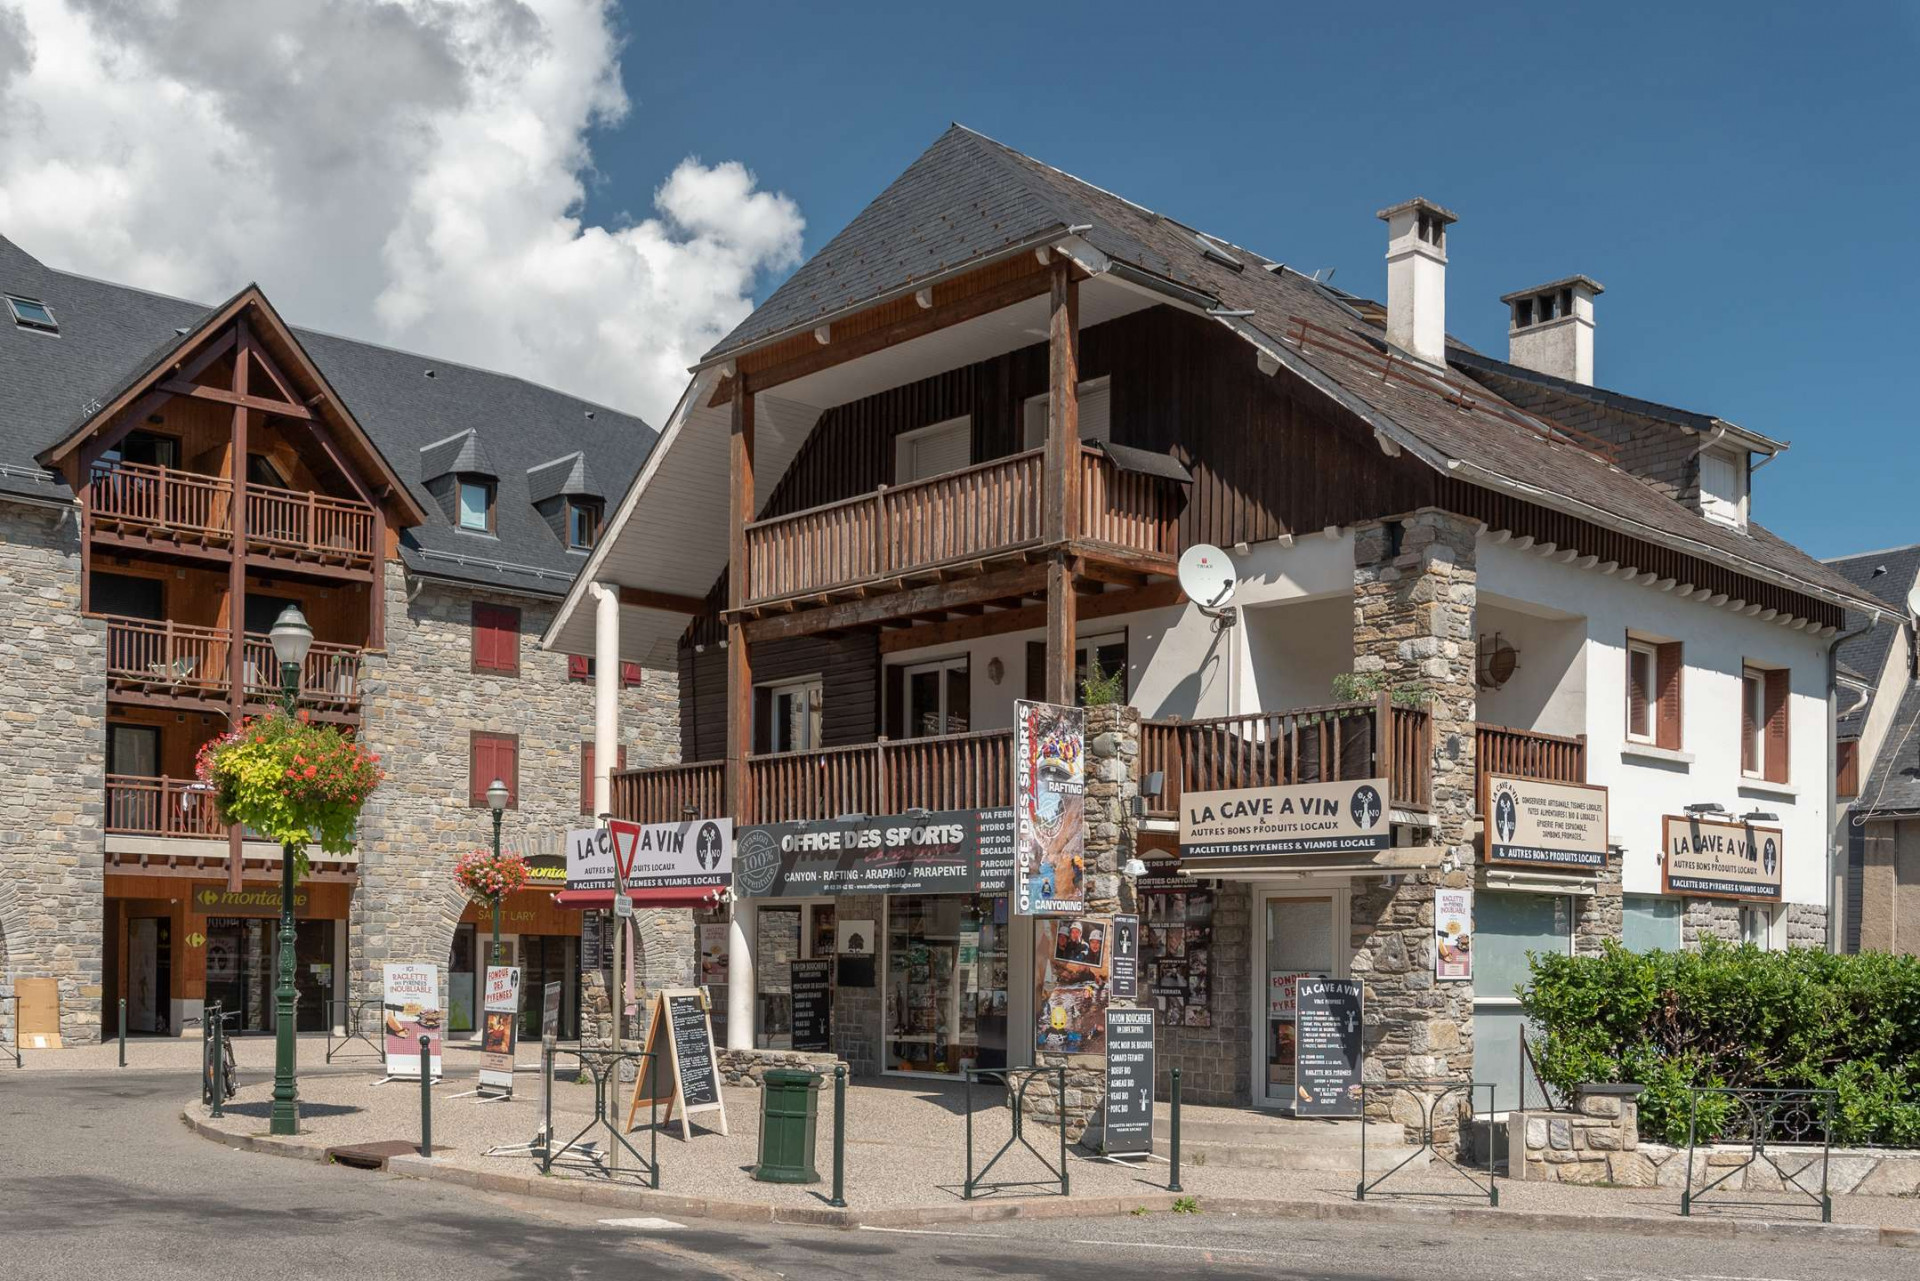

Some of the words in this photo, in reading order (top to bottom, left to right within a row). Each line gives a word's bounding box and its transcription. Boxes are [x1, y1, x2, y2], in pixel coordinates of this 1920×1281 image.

[1019, 705, 1030, 788] SPORTS
[1049, 782, 1082, 794] RAFTING
[1496, 781, 1508, 792] CAVE
[1522, 796, 1547, 806] CONSERVERIE
[1020, 793, 1030, 832] DES
[1190, 806, 1215, 825] LA
[1220, 798, 1273, 818] CAVE
[1280, 798, 1294, 814] A
[1300, 798, 1338, 817] VIN
[1191, 828, 1224, 837] AUTRES
[1228, 826, 1251, 835] BONS
[1253, 824, 1298, 833] PRODUITS
[1301, 822, 1338, 831] LOCAUX
[577, 838, 594, 860] LA
[641, 830, 651, 851] A
[656, 830, 685, 854] VIN
[781, 832, 840, 852] OFFICE
[845, 829, 882, 848] DES
[885, 824, 964, 846] SPORTS
[1189, 845, 1230, 854] RACLETTE
[1233, 844, 1248, 852] DES
[1250, 842, 1293, 851] PYRENEES
[1304, 840, 1337, 849] VIANDE
[1340, 838, 1376, 848] LOCALE
[1674, 836, 1689, 855] LA
[1693, 834, 1723, 854] CAVE
[1727, 838, 1735, 855] A
[1738, 840, 1758, 862] VIN
[742, 850, 774, 872] 100%
[1499, 848, 1504, 856] &
[1508, 848, 1532, 859] AUTRES
[1533, 851, 1548, 860] BONS
[1550, 851, 1577, 862] PRODUITS
[1579, 854, 1601, 863] LOCAUX
[652, 864, 675, 872] LOCAUX
[784, 871, 816, 882] CANYON
[824, 870, 858, 880] RAFTING
[865, 869, 905, 879] ARAPAHO
[914, 866, 967, 877] PARAPENTE
[1674, 860, 1695, 870] AUTRES
[1696, 862, 1710, 871] BONS
[1711, 864, 1736, 873] PRODUITS
[1738, 866, 1758, 875] LOCAUX
[574, 882, 606, 890] RACLETTE
[665, 877, 692, 886] VIANDE
[693, 876, 721, 885] LOCALE
[742, 867, 774, 888] aventure
[1020, 840, 1030, 911] OFFICE
[1672, 879, 1698, 888] RACLETTE
[1709, 882, 1734, 891] PYRENEES
[1739, 885, 1756, 893] VIANDE
[1757, 886, 1774, 894] LOCALE
[1035, 900, 1082, 911] CANYONING
[478, 910, 507, 920] SAIT
[511, 911, 536, 920] LARY
[488, 968, 509, 981] FONDUE
[390, 986, 432, 994] INOUBLIABLE
[493, 980, 503, 991] DES
[1285, 987, 1296, 996] DE
[1301, 986, 1313, 996] LA
[1314, 983, 1334, 993] CAVE
[1336, 984, 1342, 993] A
[1344, 985, 1359, 996] VIN
[486, 989, 513, 1003] PYRENEES
[1108, 1013, 1125, 1023] RAYON
[1126, 1013, 1151, 1023] BOUCHERIE
